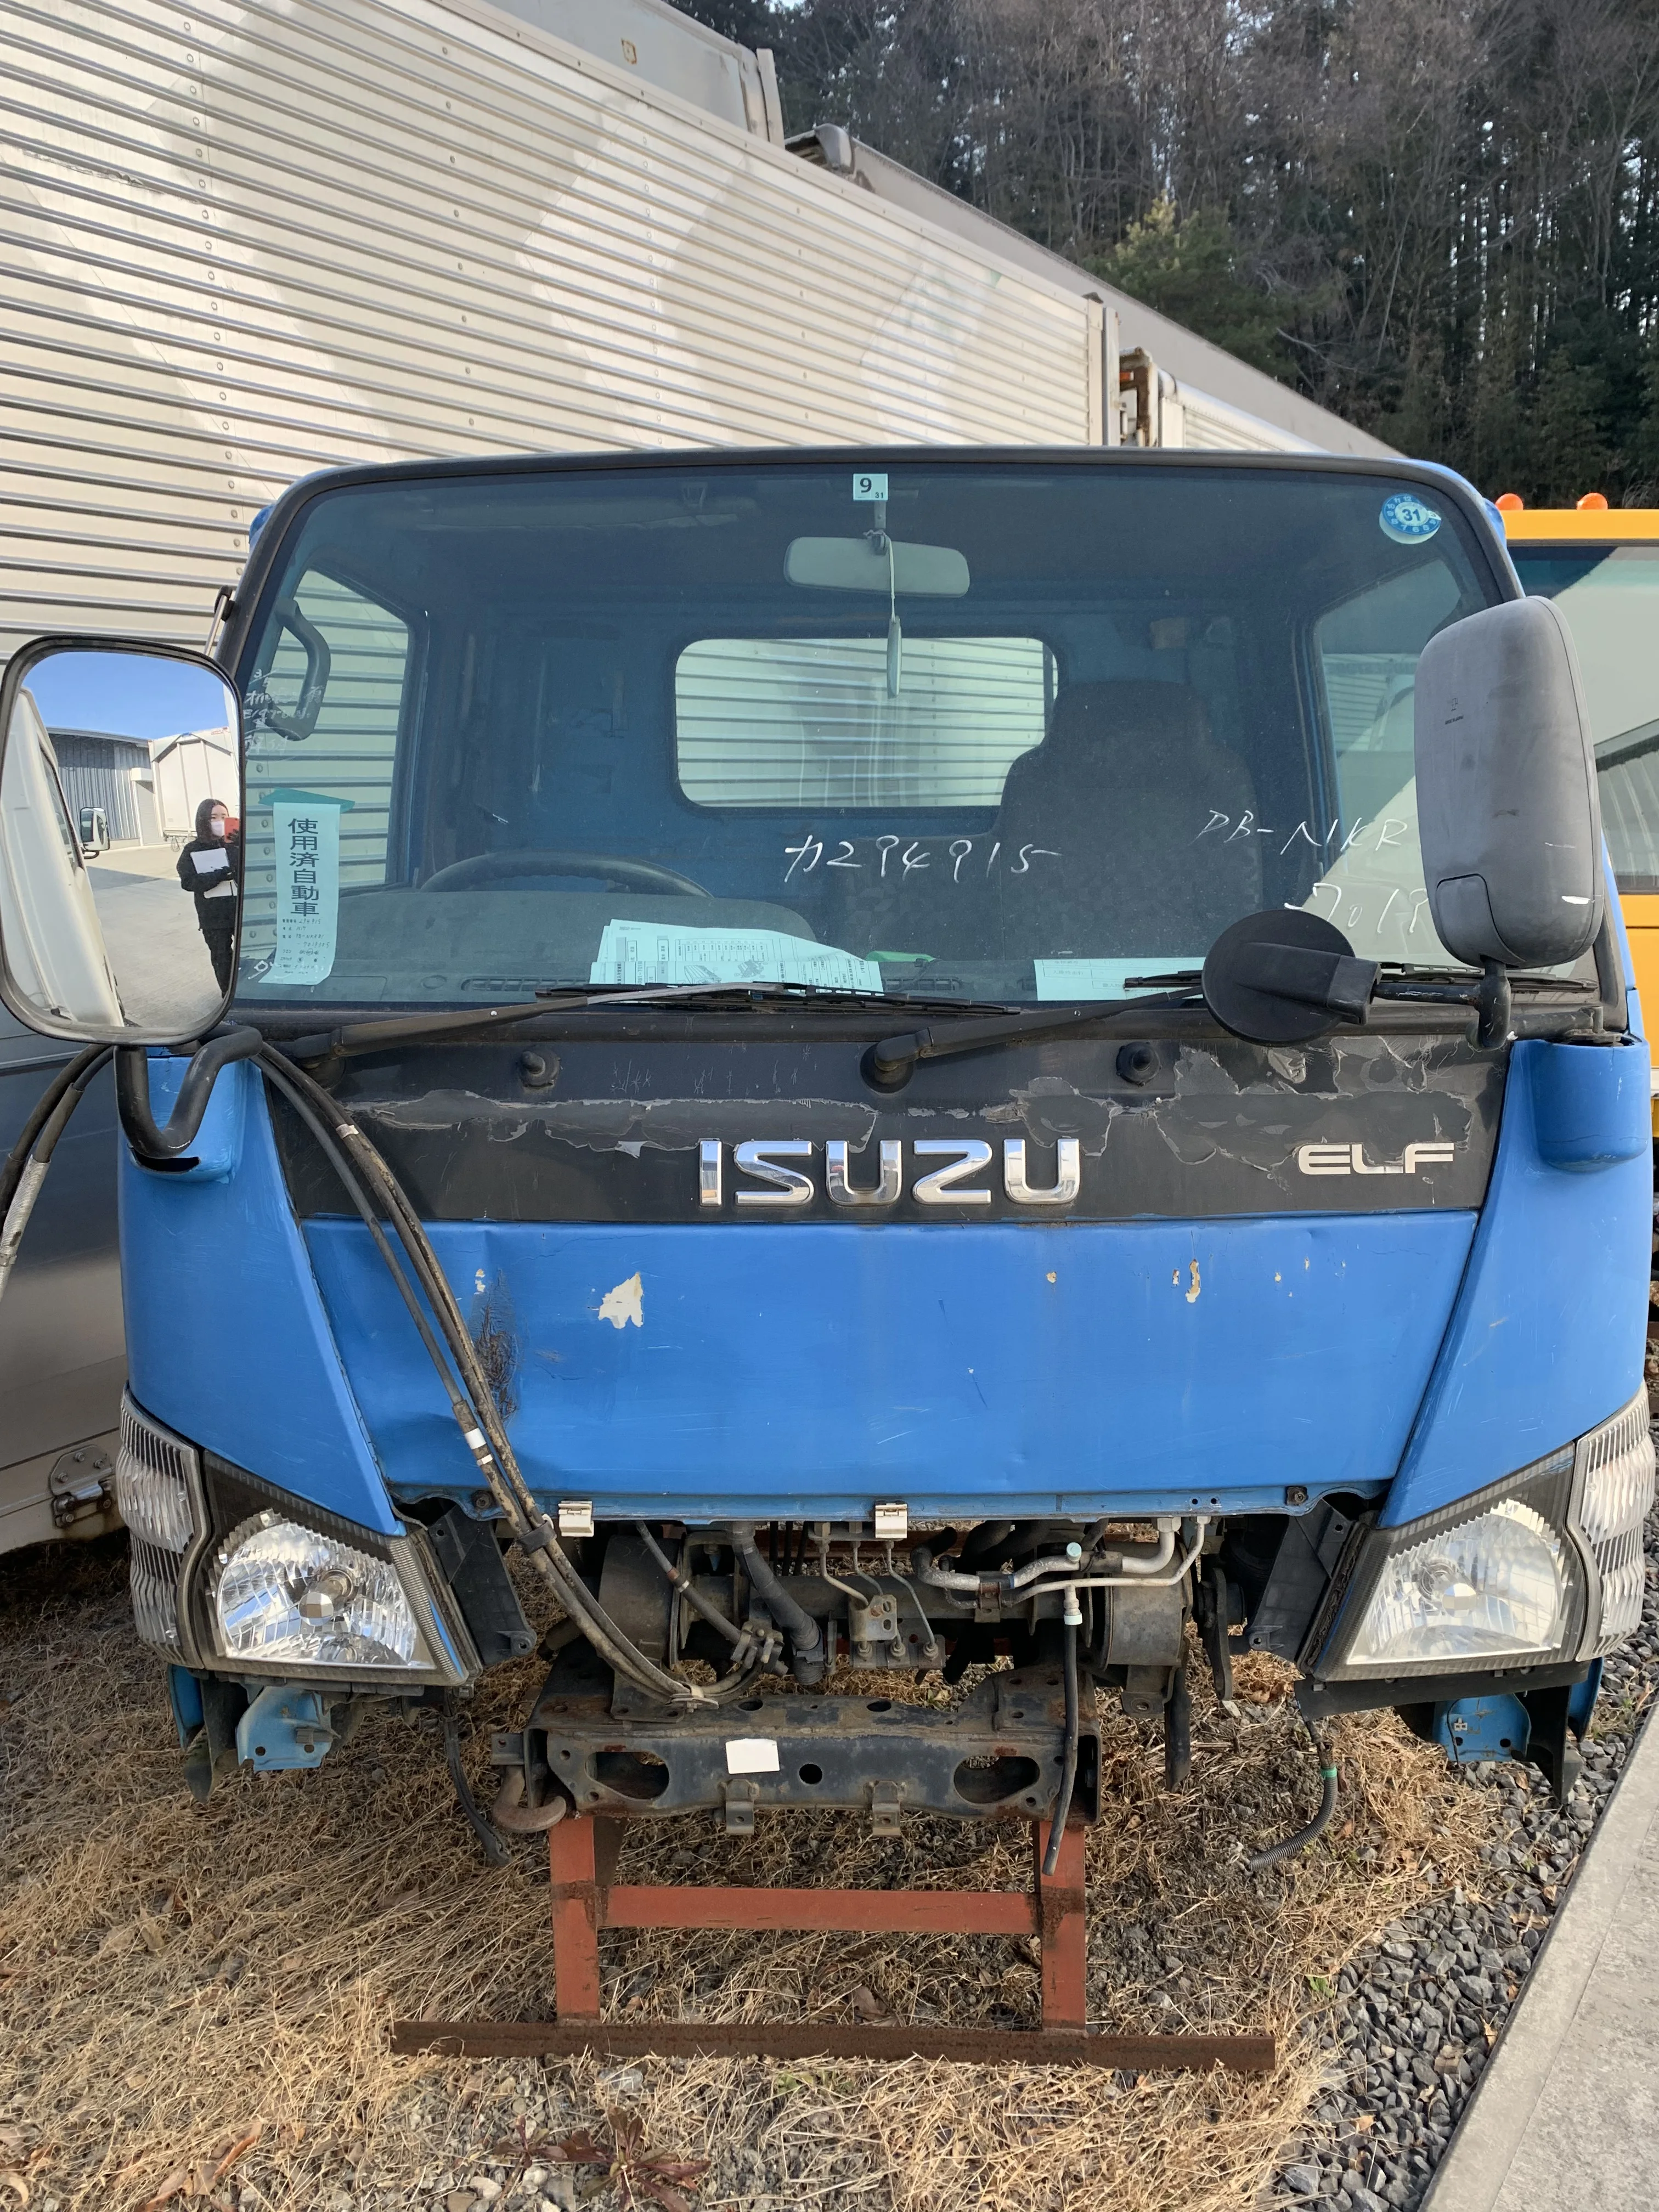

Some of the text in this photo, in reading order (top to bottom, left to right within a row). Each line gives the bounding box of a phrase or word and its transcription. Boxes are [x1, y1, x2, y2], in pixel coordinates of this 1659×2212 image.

[860, 477, 872, 493] 9
[1402, 509, 1421, 522] 31
[287, 818, 320, 917] 使用済自動車
[698, 1137, 1081, 1207] ISUZU
[1298, 1142, 1455, 1175] ELF
